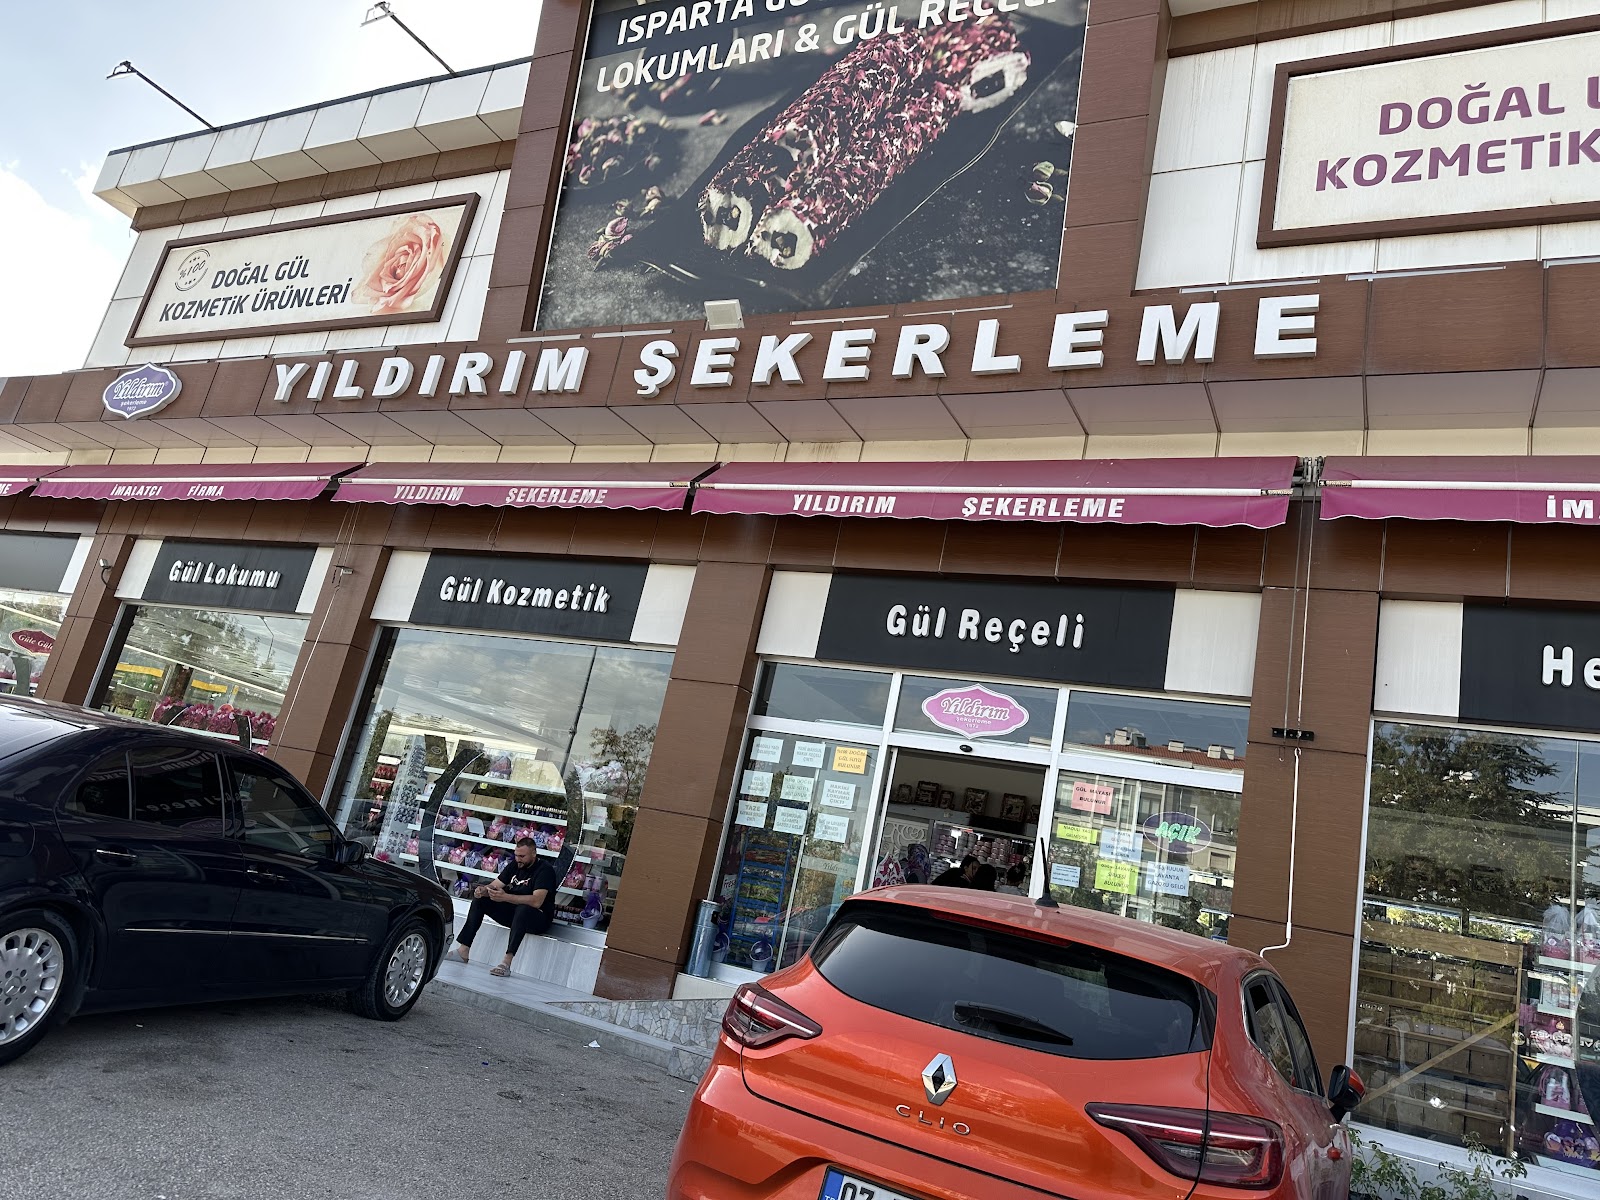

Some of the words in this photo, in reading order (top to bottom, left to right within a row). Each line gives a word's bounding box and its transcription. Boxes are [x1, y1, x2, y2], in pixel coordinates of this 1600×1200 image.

[617, 0, 754, 45] ISPARTA
[596, 29, 785, 93] LOKUMLARI
[794, 23, 820, 52] &
[832, 1, 905, 45] GÜL
[1379, 81, 1565, 136] DOĞAL
[211, 262, 269, 290] DOĞAL
[274, 256, 310, 280] GÜL
[250, 278, 353, 312] ÜRÜNLERİ
[274, 347, 590, 404] YILDIRIM
[633, 294, 1320, 399] ŞEKERLEME
[110, 483, 164, 498] İMALATÇI
[187, 483, 225, 497] FİRMA
[393, 485, 465, 501] YILDIRIM
[505, 488, 608, 504] ŞEKERLEME
[793, 494, 896, 514] YILDIRIM
[962, 496, 1126, 519] ŞEKERLEME
[1546, 495, 1600, 519] İM
[168, 559, 203, 583] Gül
[203, 562, 282, 589] Lokumu
[440, 575, 483, 603] Gül
[486, 578, 611, 614] Kozmetik
[886, 604, 947, 639] Gül
[958, 608, 1085, 653] Reçeli
[1155, 821, 1202, 845] AÇIK
[895, 1104, 971, 1136] CLIO
